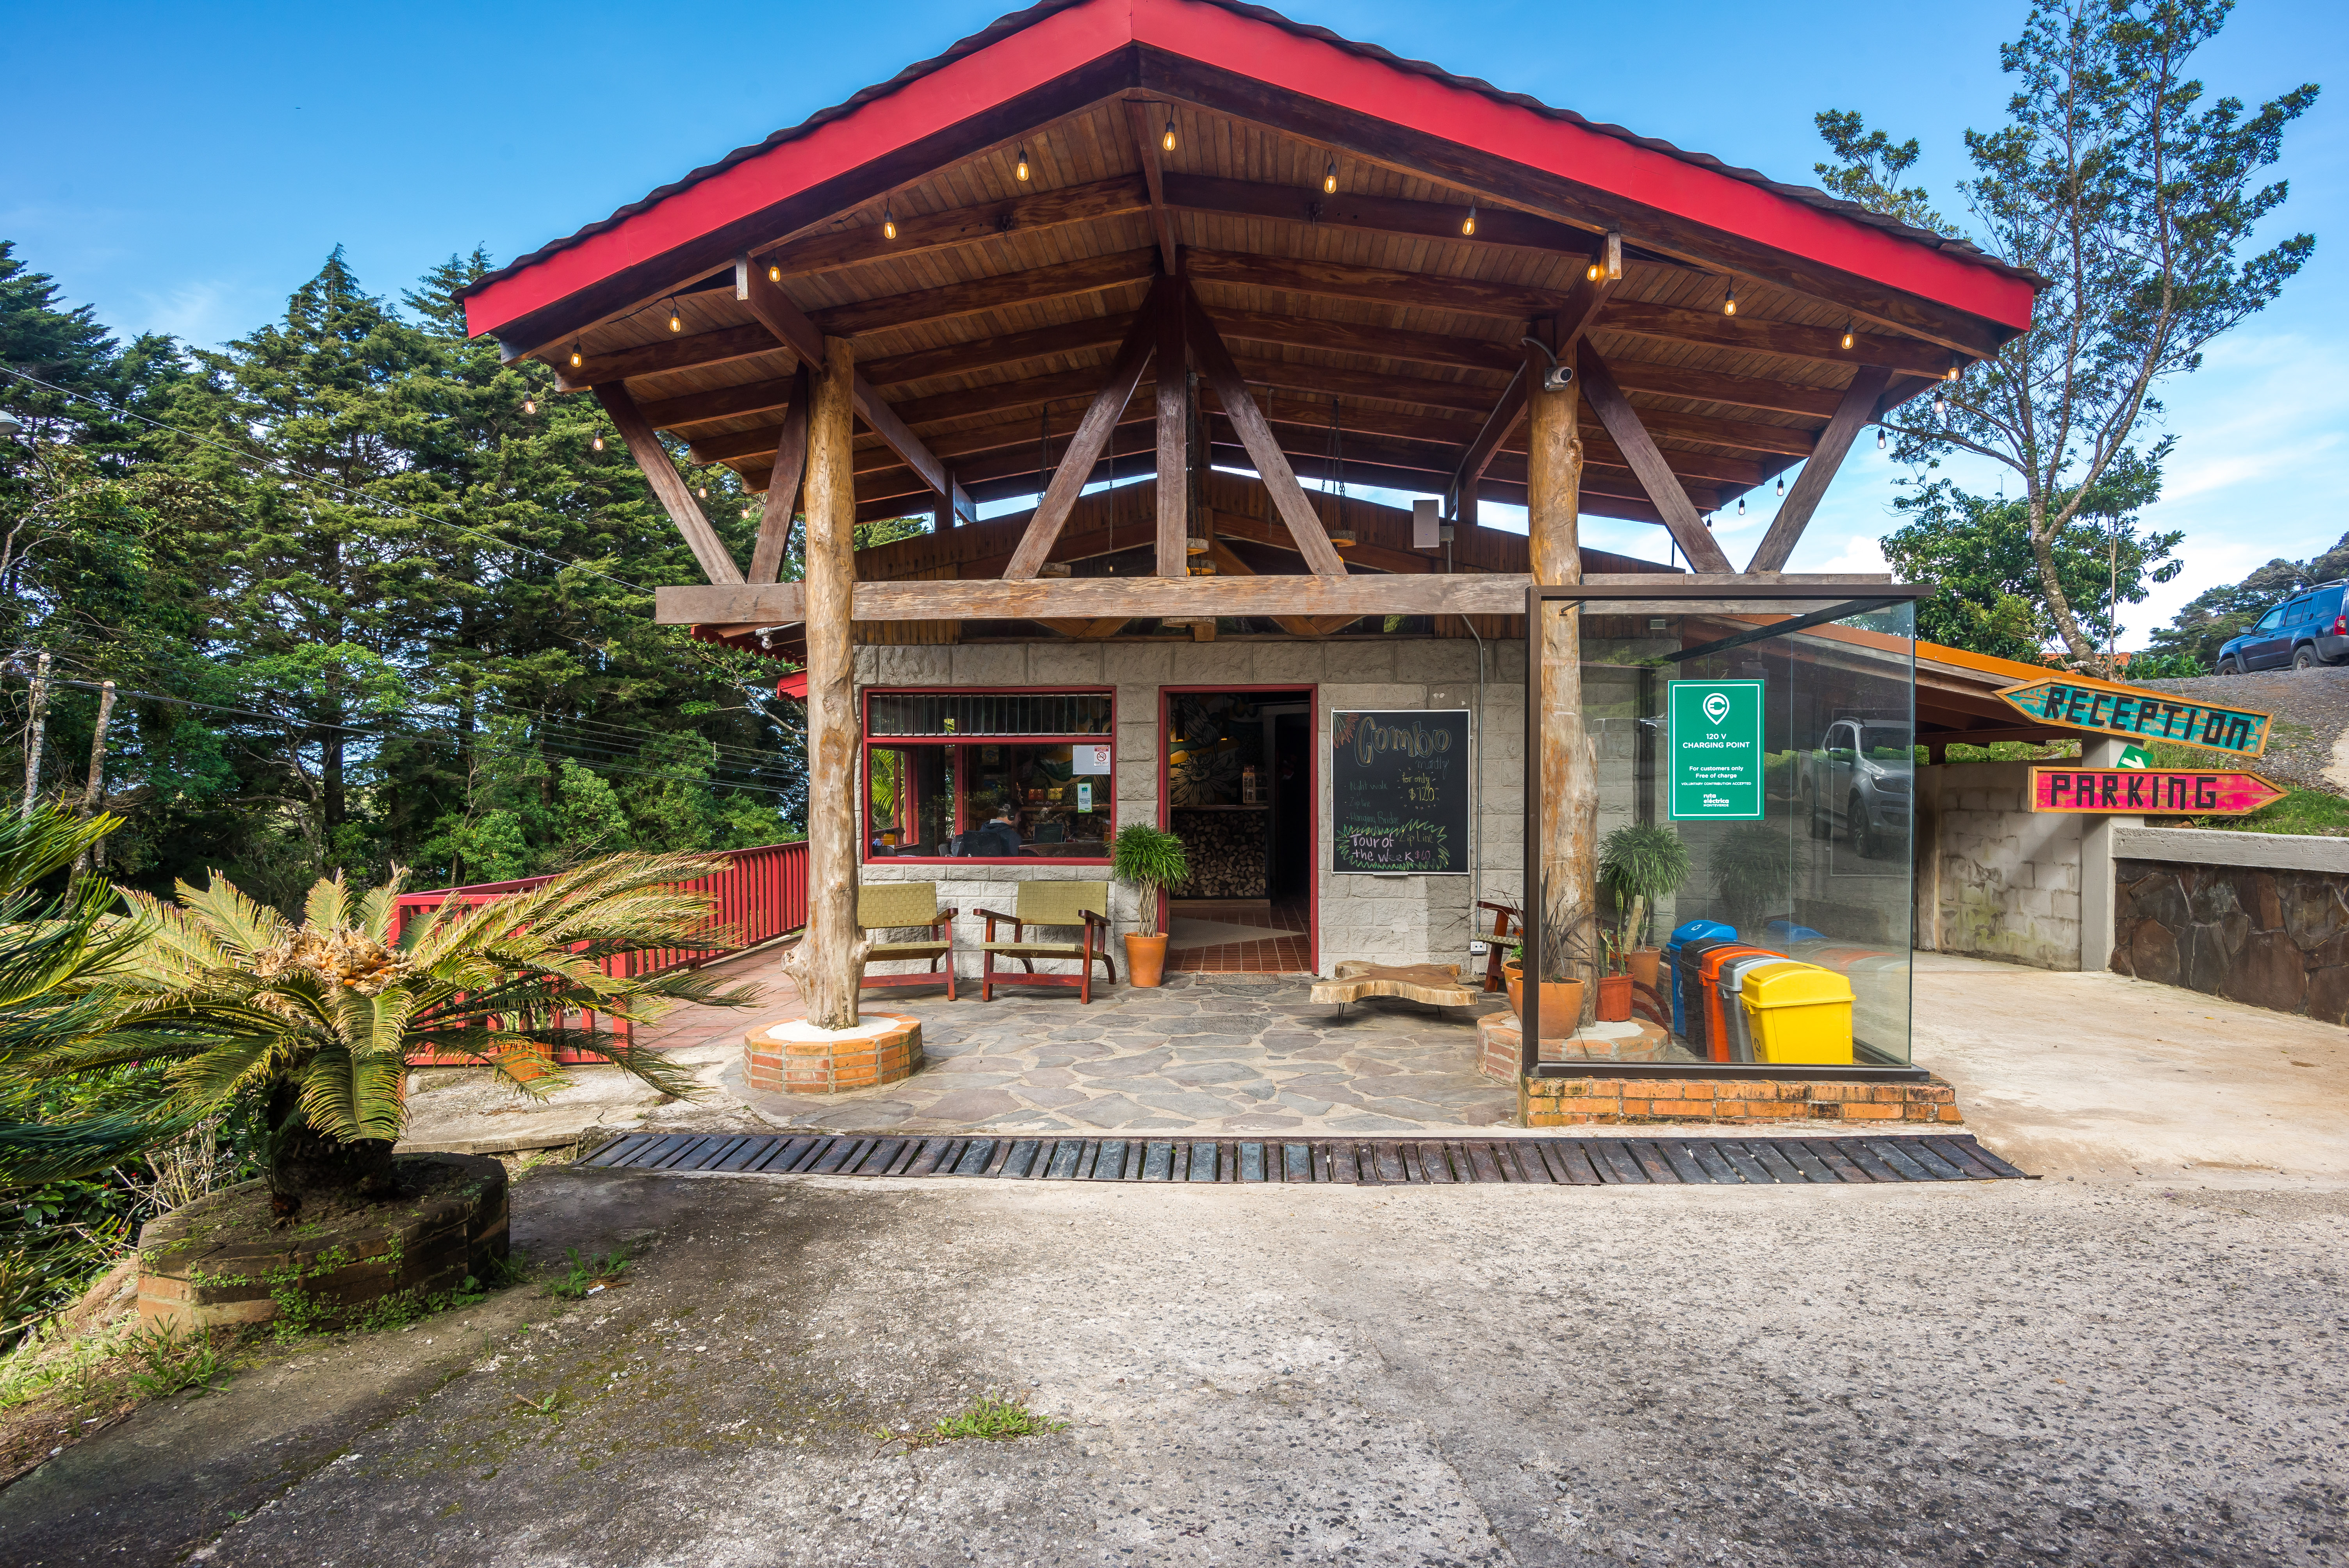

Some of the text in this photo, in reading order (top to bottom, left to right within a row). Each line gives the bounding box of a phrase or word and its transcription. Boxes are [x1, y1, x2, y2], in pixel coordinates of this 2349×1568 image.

[2043, 686, 2251, 750] RECEPTION
[1355, 716, 1452, 767] Combo
[1401, 772, 1430, 791] for only
[1408, 787, 1434, 801] $120
[2051, 774, 2217, 810] PARKING
[1350, 811, 1401, 829] Hanging Bridge
[1349, 832, 1394, 848] Tour of
[1417, 830, 1434, 843] Line
[1352, 848, 1374, 862] the
